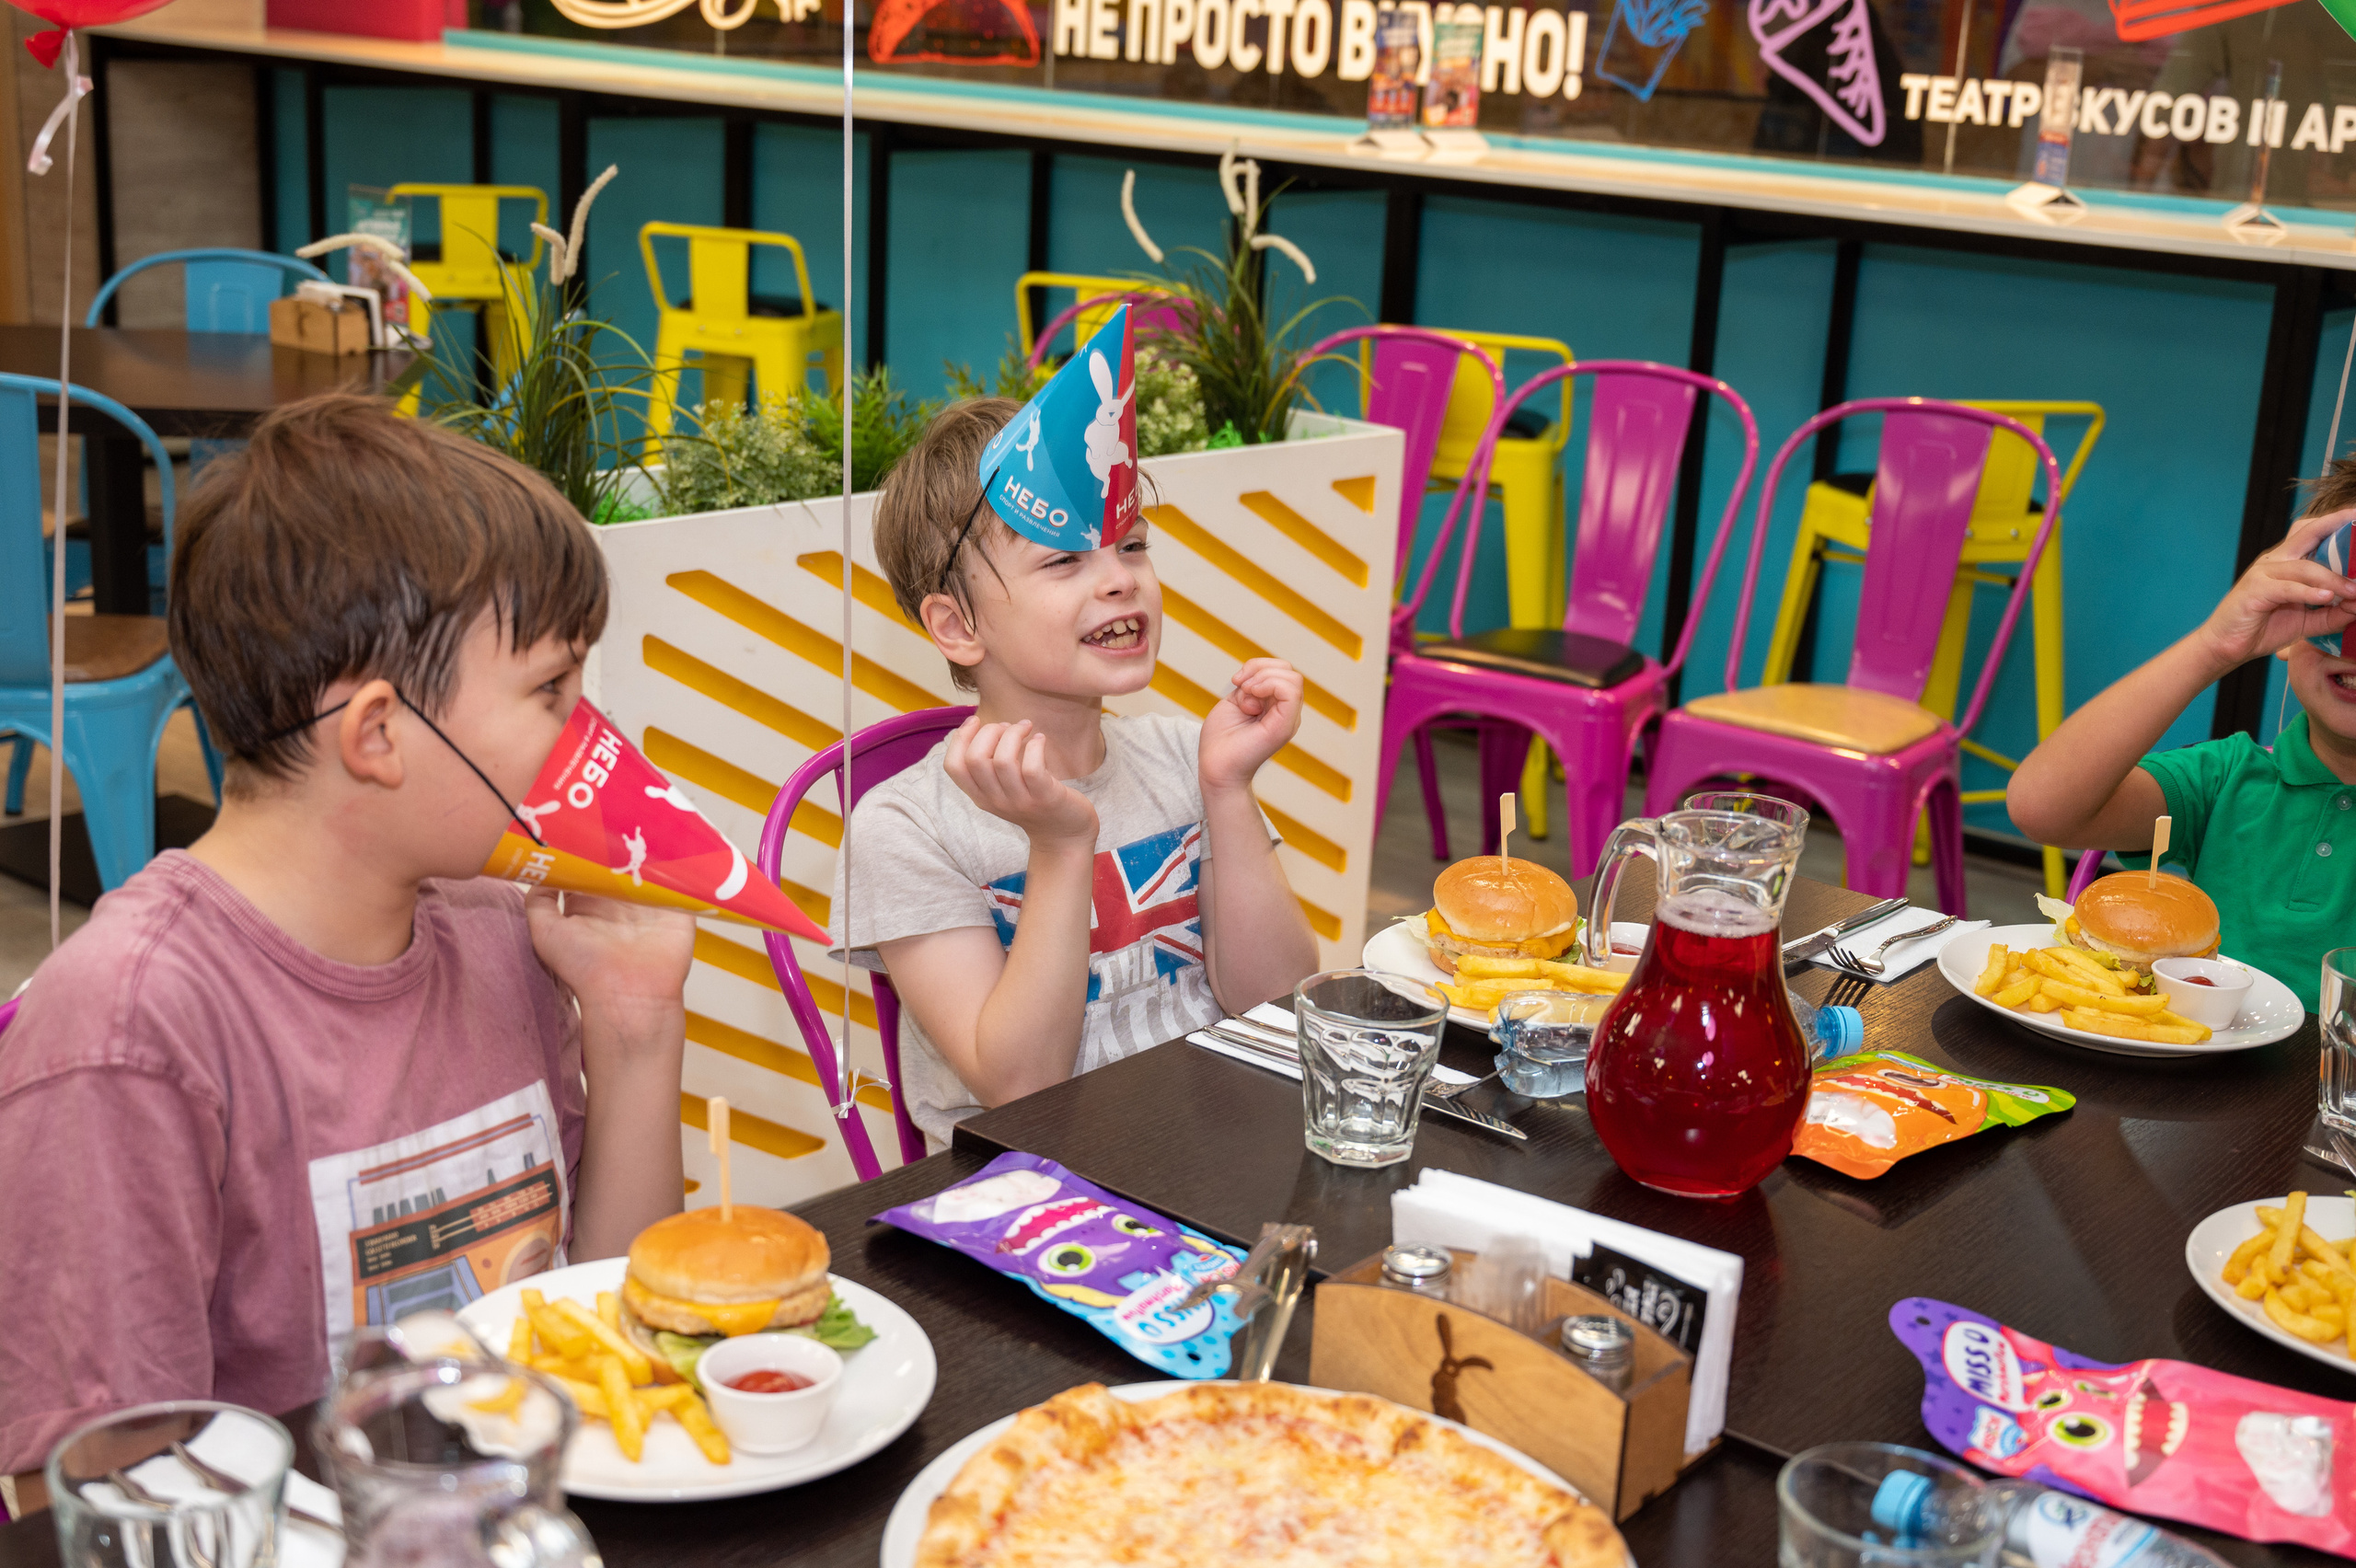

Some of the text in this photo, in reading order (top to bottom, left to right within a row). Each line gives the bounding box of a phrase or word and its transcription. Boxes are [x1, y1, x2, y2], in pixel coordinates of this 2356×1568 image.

[1053, 0, 1120, 60] НЕ
[1125, 0, 1333, 78] ПРОСТО
[1900, 72, 2042, 128] ТЕАТР
[2070, 85, 2241, 144] КУСОВ
[999, 493, 1060, 537] СПОРТ И РАЗВЛЕЧЕНИЯ
[1004, 474, 1068, 527] НЕБО
[1115, 486, 1138, 520] НЕ
[567, 728, 623, 809] НЕБО
[1095, 941, 1159, 995] THE
[1965, 1345, 1993, 1399] MISS
